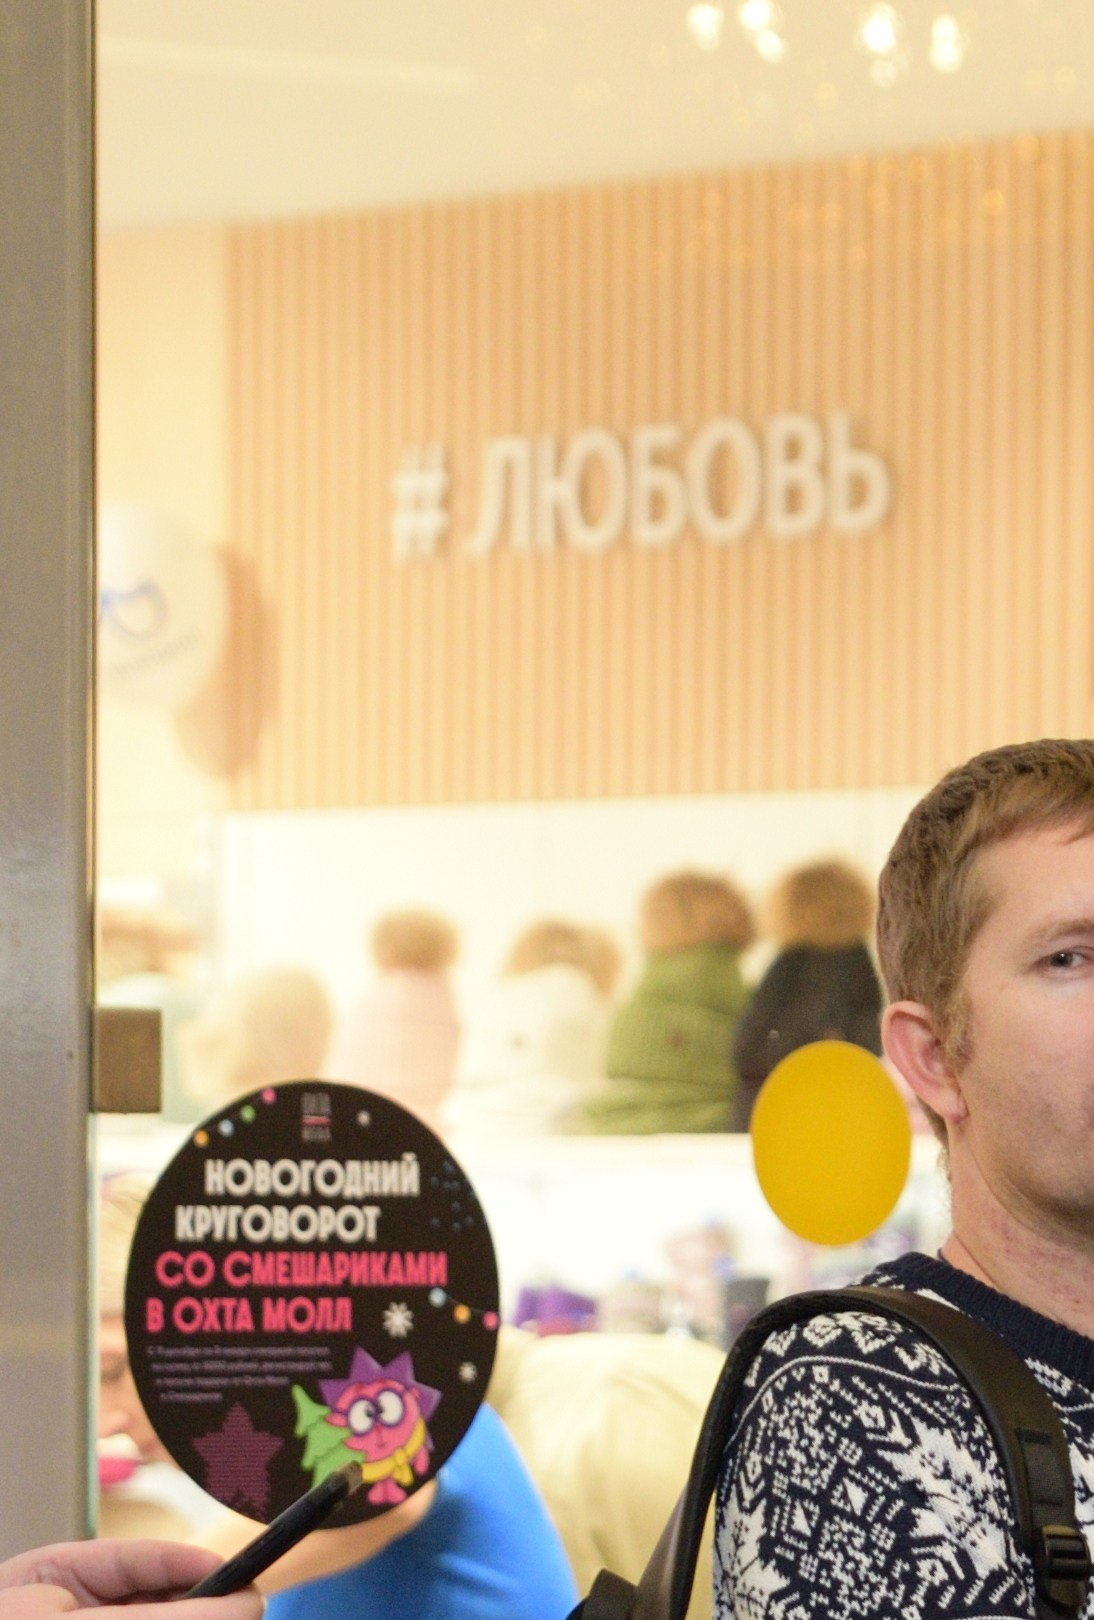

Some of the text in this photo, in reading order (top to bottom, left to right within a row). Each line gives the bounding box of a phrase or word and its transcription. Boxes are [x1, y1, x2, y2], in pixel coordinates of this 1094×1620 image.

[204, 1152, 420, 1199] НОВОГОДНИЙ
[175, 1205, 381, 1242] КРУГОВОРОТ
[155, 1250, 448, 1288] СО СМЕШАРИКАМИ
[145, 1296, 352, 1333] В ОХТА МОЛЛ
